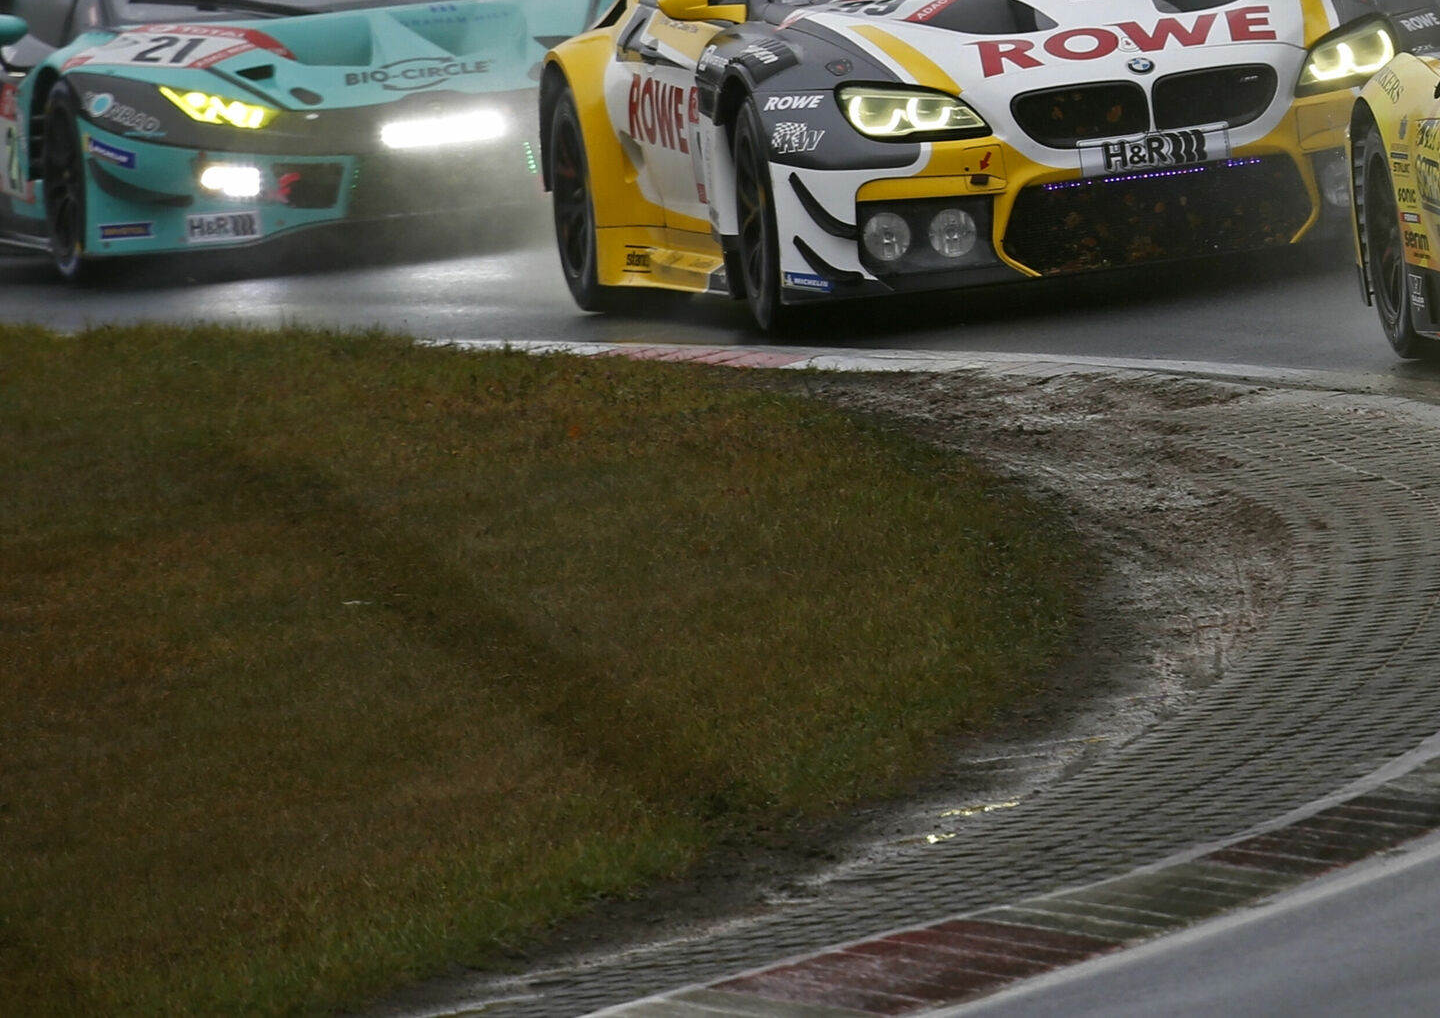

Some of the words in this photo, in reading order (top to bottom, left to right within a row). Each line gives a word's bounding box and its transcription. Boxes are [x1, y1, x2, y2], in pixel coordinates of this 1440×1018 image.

[1400, 13, 1440, 32] ROWE
[131, 36, 207, 64] 21
[962, 5, 1277, 78] ROWE
[344, 61, 490, 87] BIO-CIRCLE
[628, 72, 690, 155] ROWE
[764, 93, 826, 112] ROWE
[1103, 133, 1168, 173] H&R
[189, 217, 230, 238] H&R
[794, 274, 830, 289] MICHELIN
